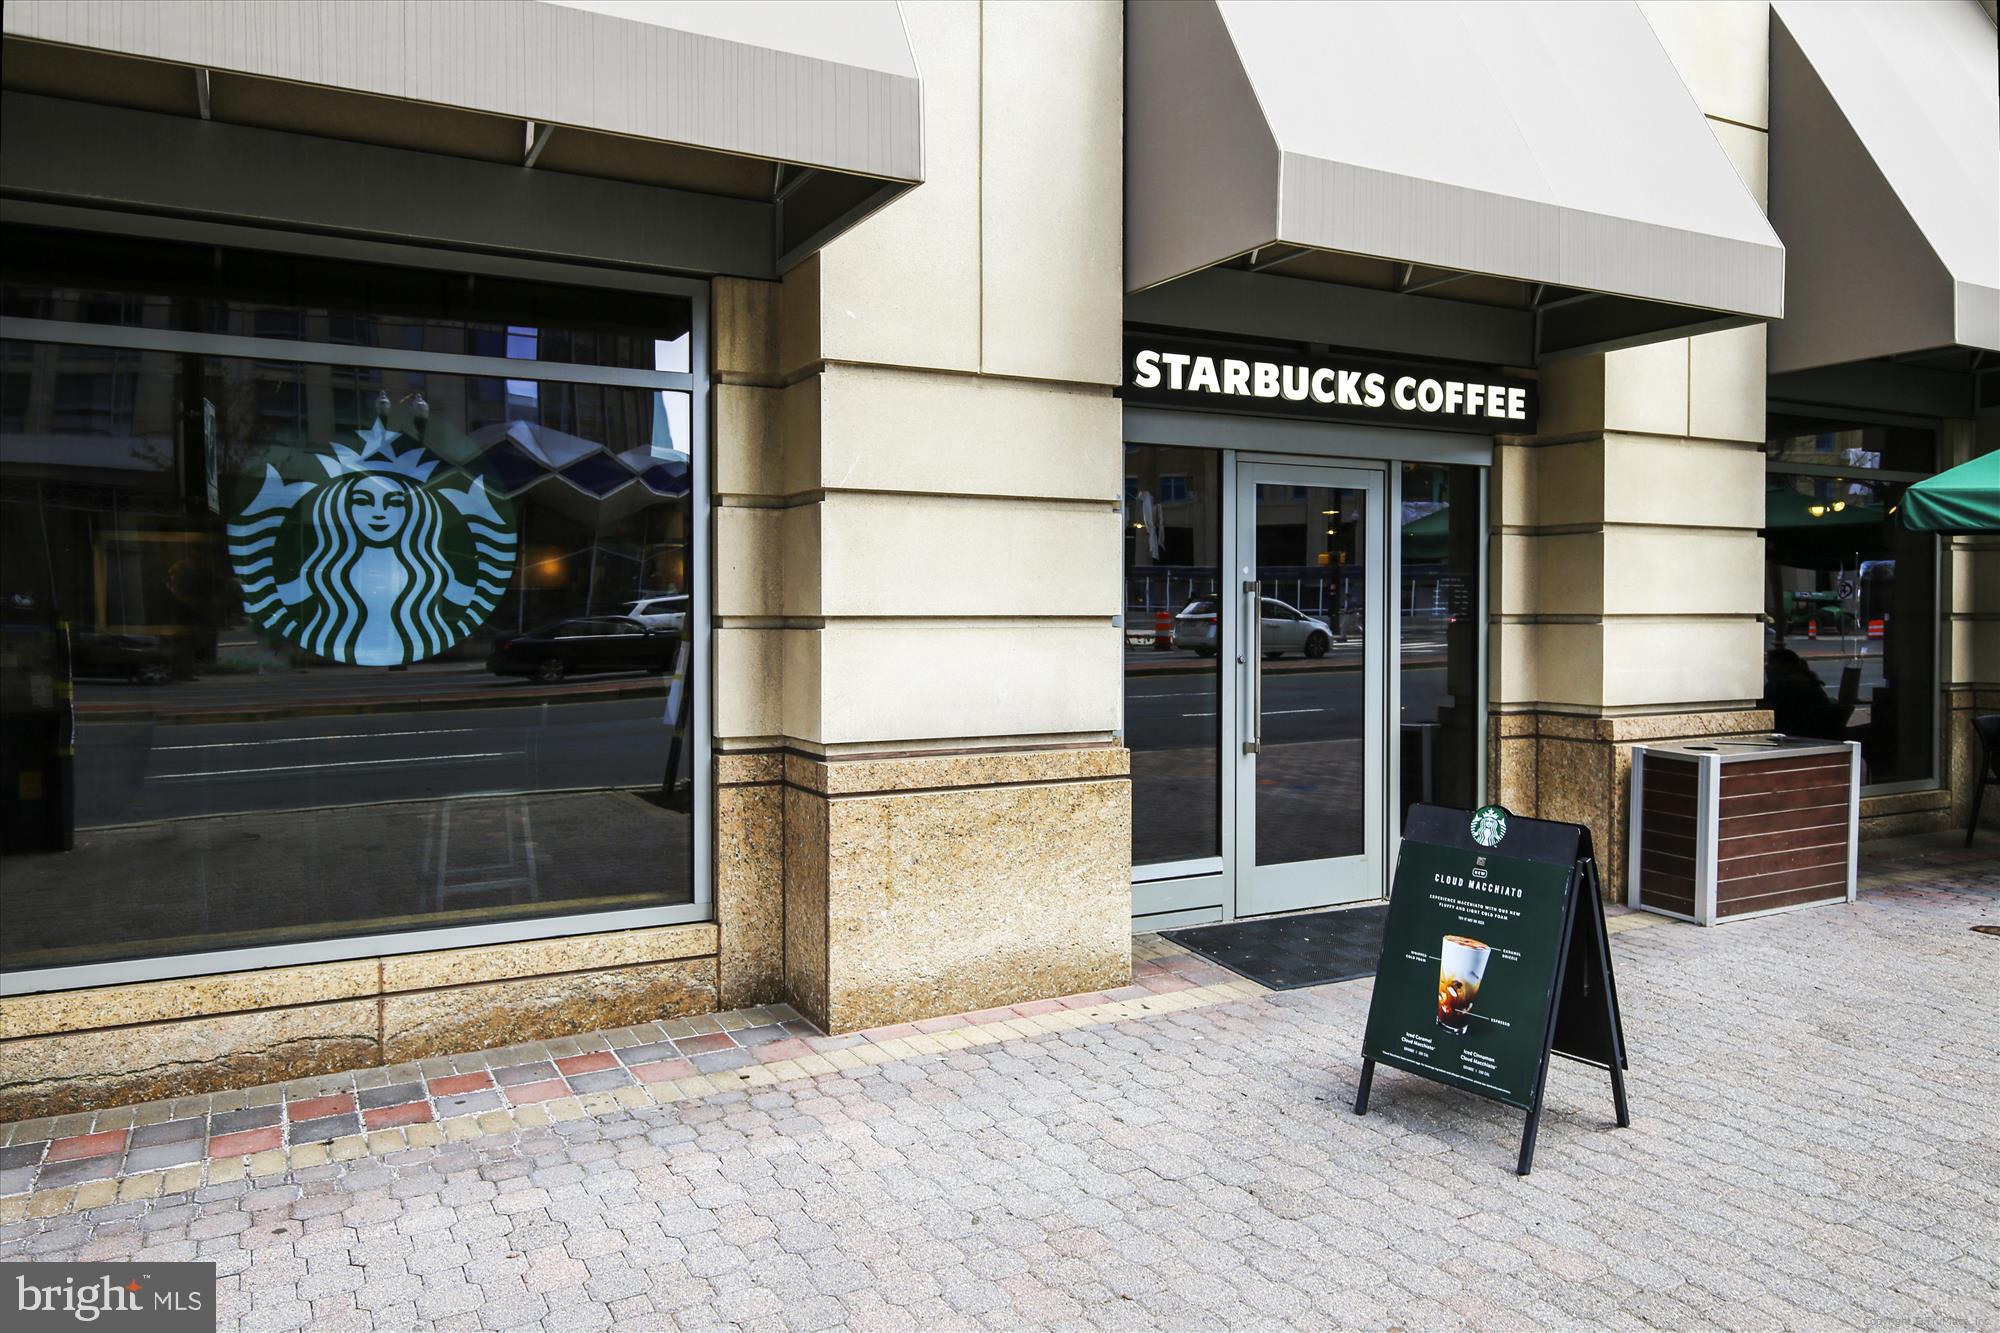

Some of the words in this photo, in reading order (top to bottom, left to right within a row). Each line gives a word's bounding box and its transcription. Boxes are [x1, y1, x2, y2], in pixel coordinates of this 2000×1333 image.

[1132, 349, 1385, 408] STARBUCKS
[1390, 376, 1526, 420] COFFEE
[1434, 873, 1464, 887] CLOUD
[1468, 880, 1523, 898] MACCHIATO
[1429, 894, 1456, 903] EXPERIENCE
[1457, 900, 1484, 909] MACCHIATO
[1439, 902, 1455, 910] FLUFFY
